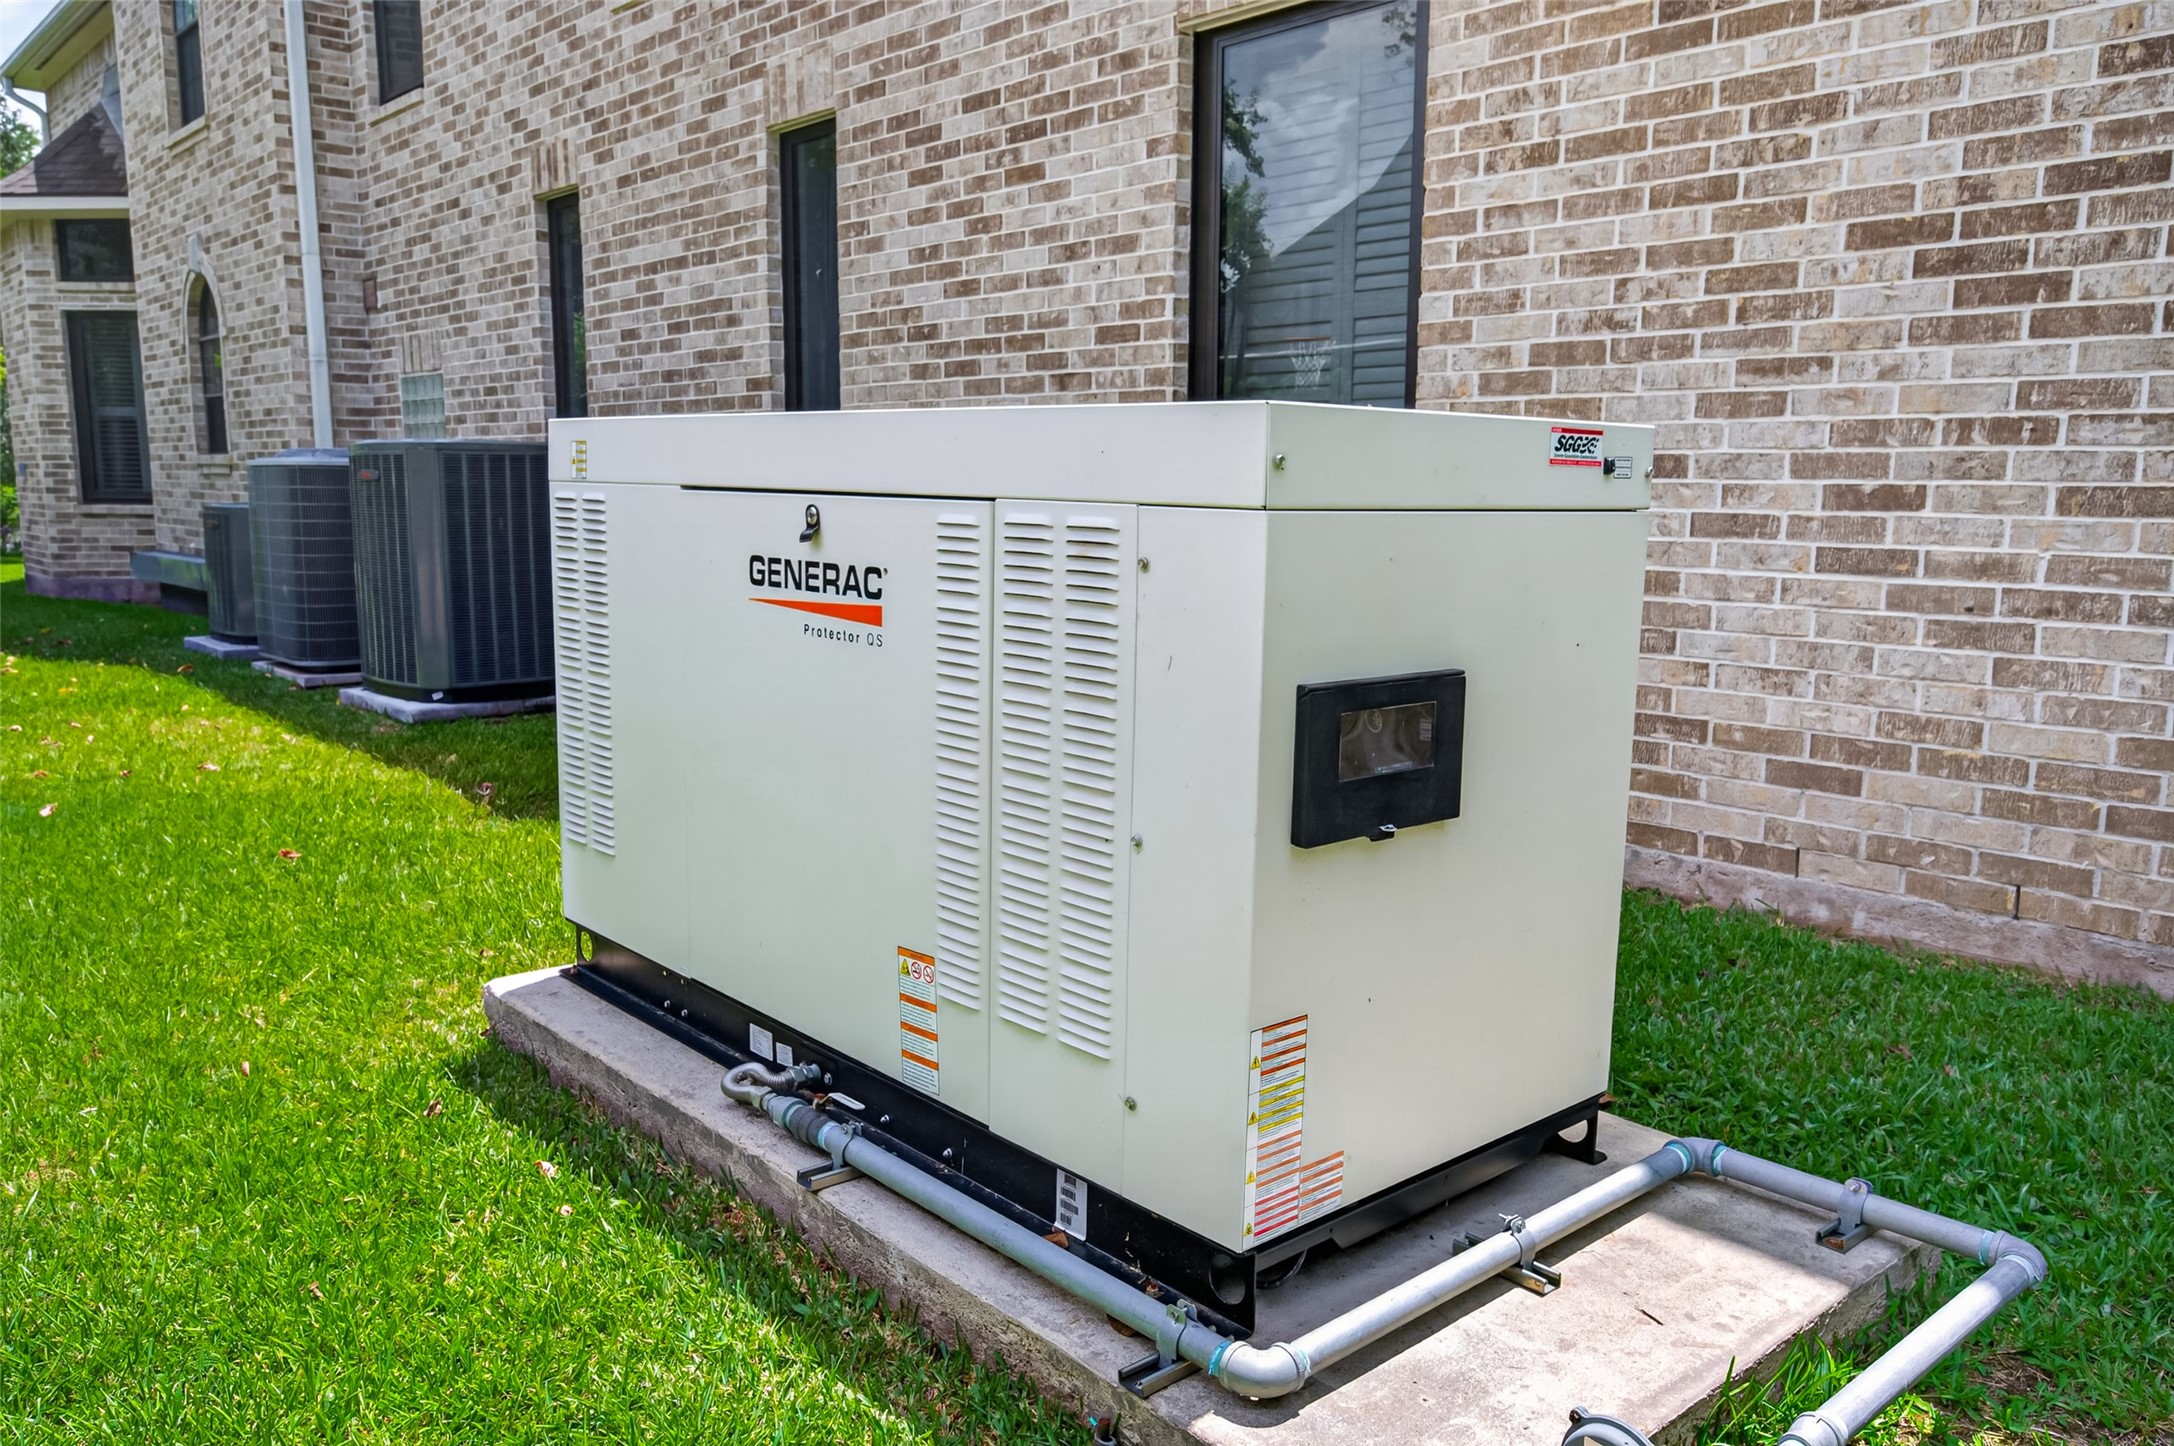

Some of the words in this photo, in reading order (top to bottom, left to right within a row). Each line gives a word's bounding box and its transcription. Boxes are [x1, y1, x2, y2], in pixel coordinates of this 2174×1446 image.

[749, 554, 883, 600] GENERAC
[803, 623, 860, 644] Protector
[866, 632, 883, 648] QS
